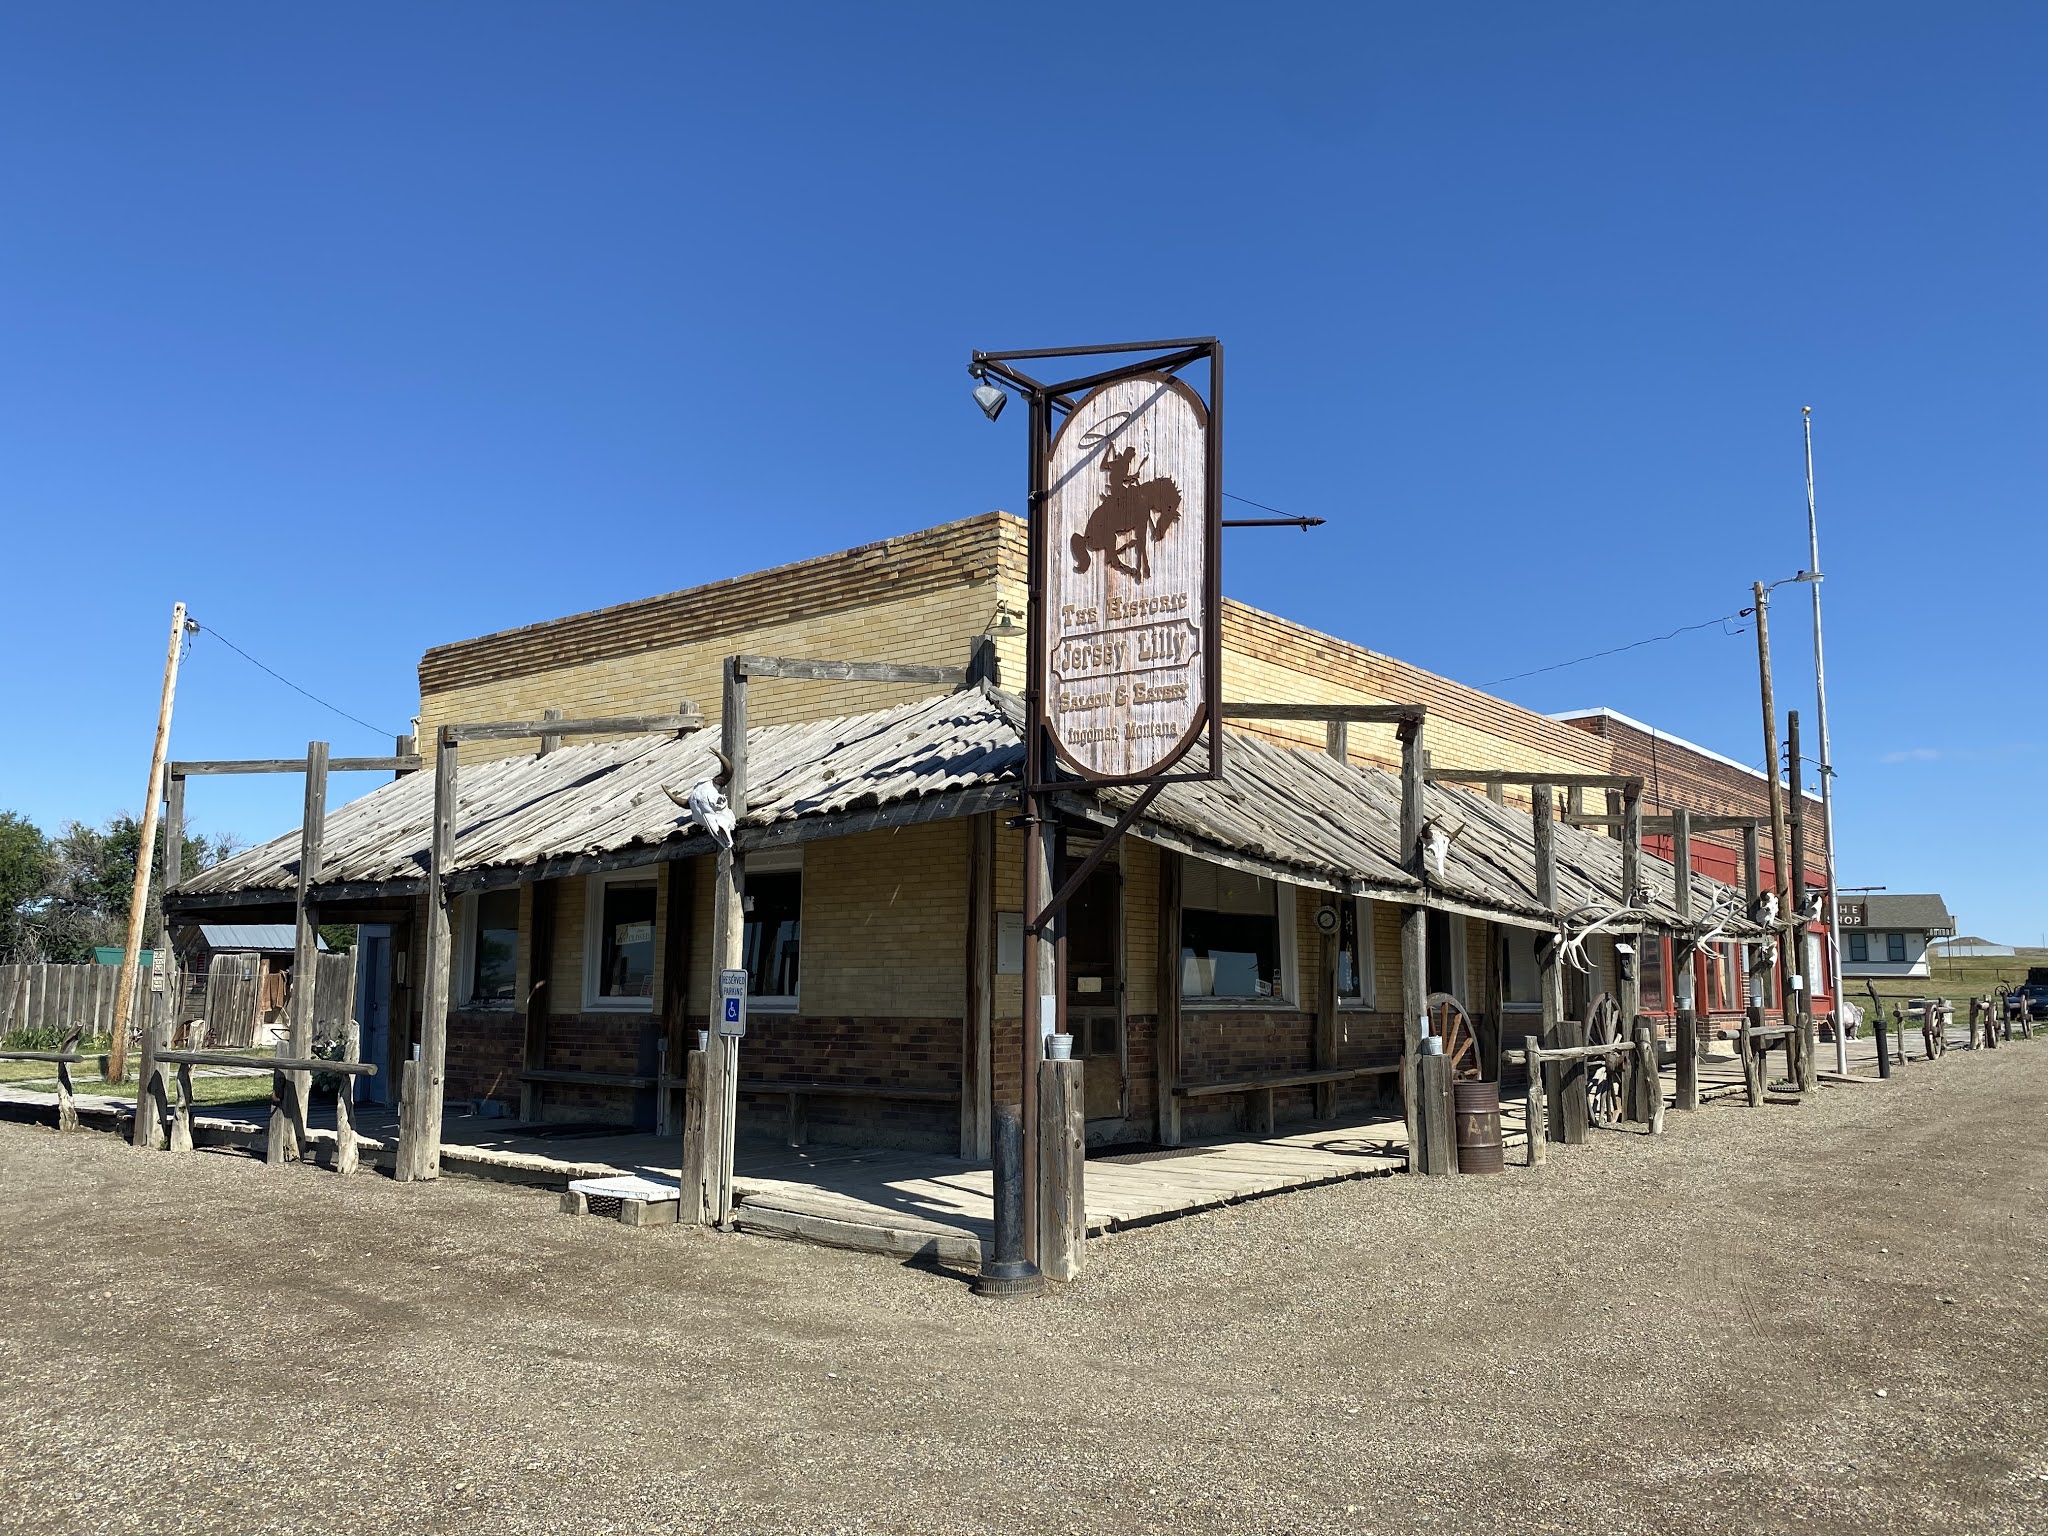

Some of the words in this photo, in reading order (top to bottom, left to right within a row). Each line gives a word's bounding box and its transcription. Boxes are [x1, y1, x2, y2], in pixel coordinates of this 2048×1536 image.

[1061, 639, 1127, 672] Jersey
[1138, 626, 1187, 663] Lilly
[1115, 683, 1128, 706] &
[1125, 720, 1179, 741] Montana
[722, 975, 745, 984] RESERVED
[723, 986, 743, 996] PARKING
